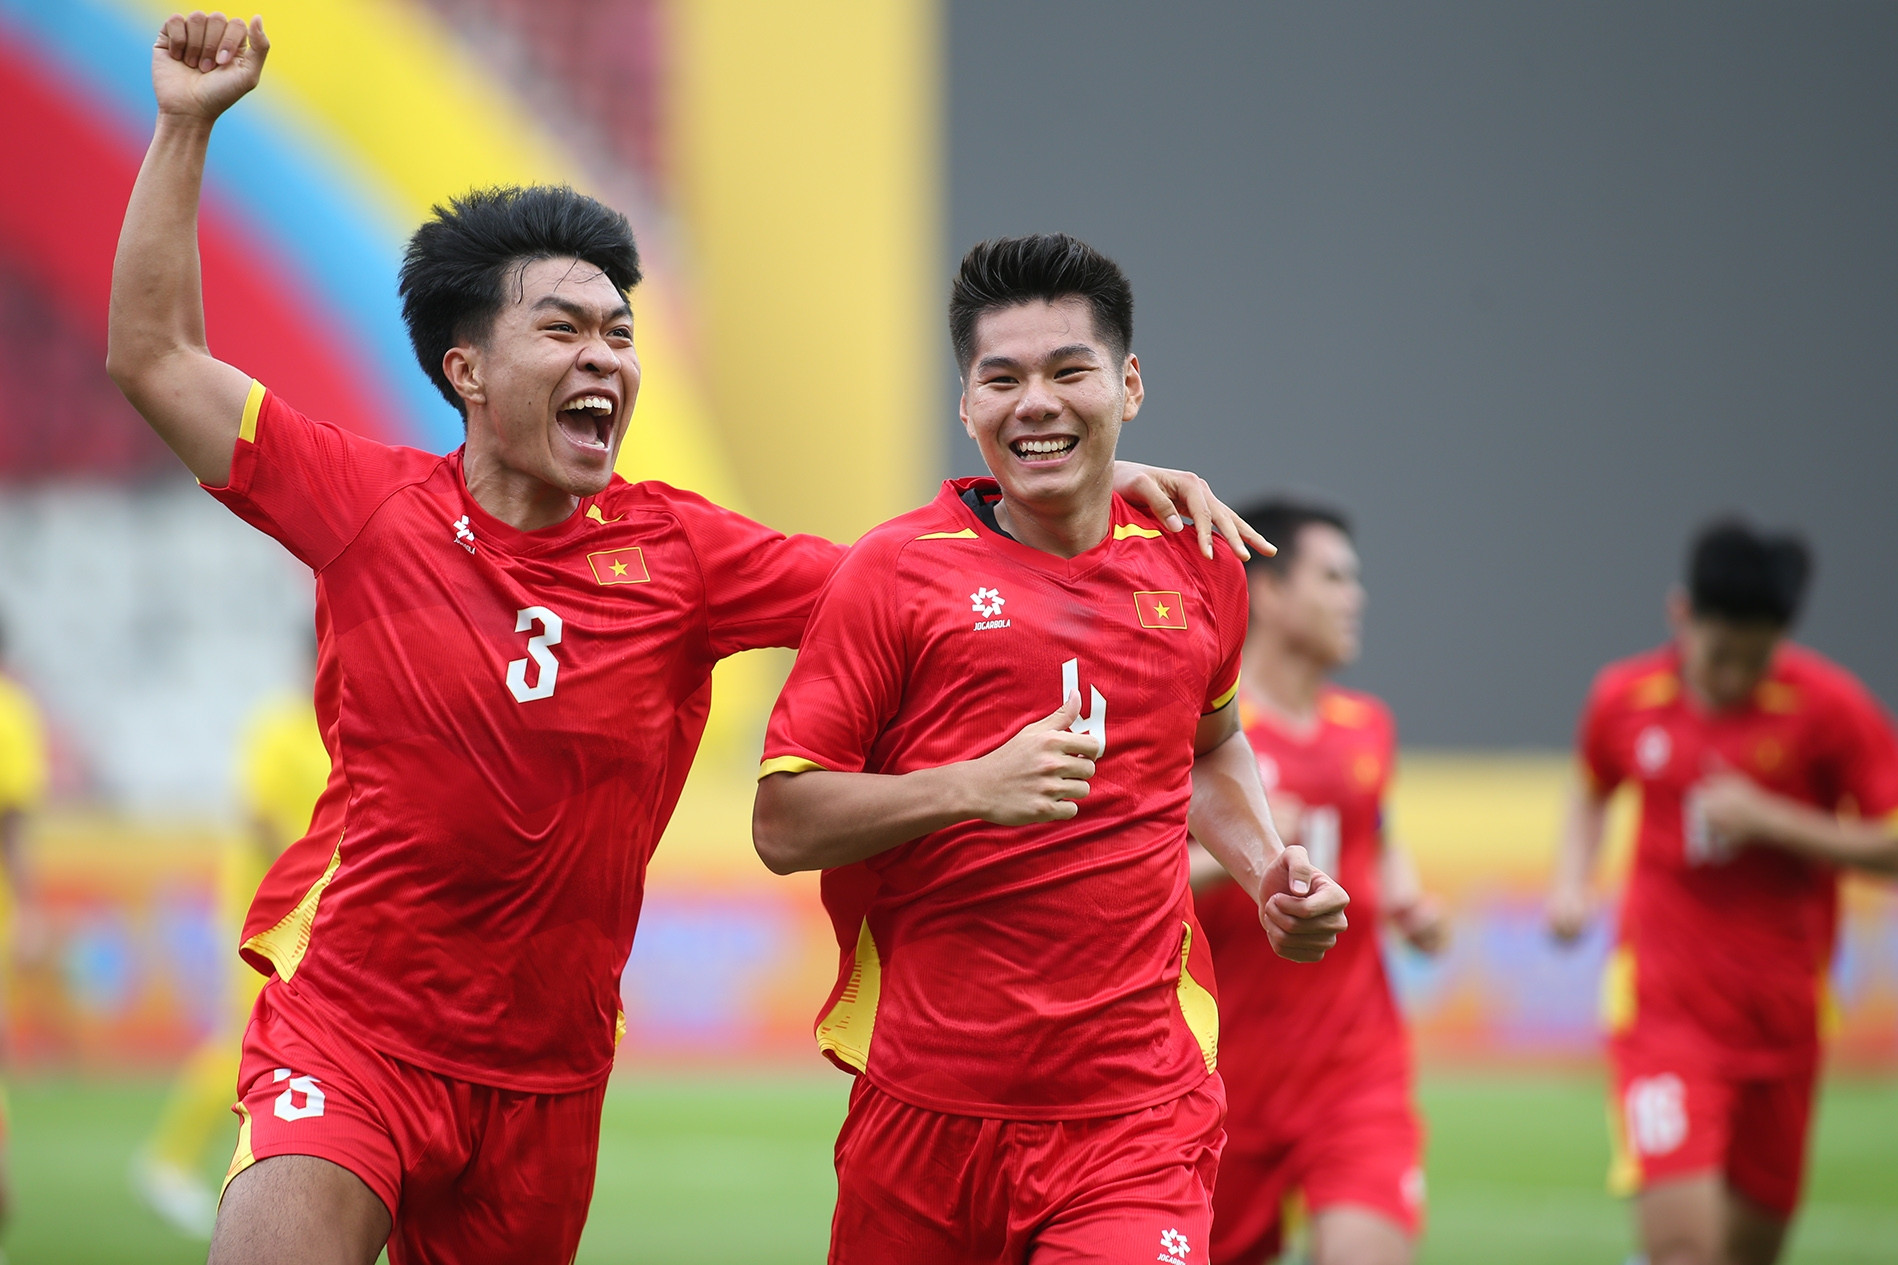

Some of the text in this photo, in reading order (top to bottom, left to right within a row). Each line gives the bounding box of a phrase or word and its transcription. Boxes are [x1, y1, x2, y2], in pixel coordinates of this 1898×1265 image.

[505, 606, 563, 703] 3
[973, 618, 1011, 632] JOGARBOLA
[1062, 657, 1107, 758] 4
